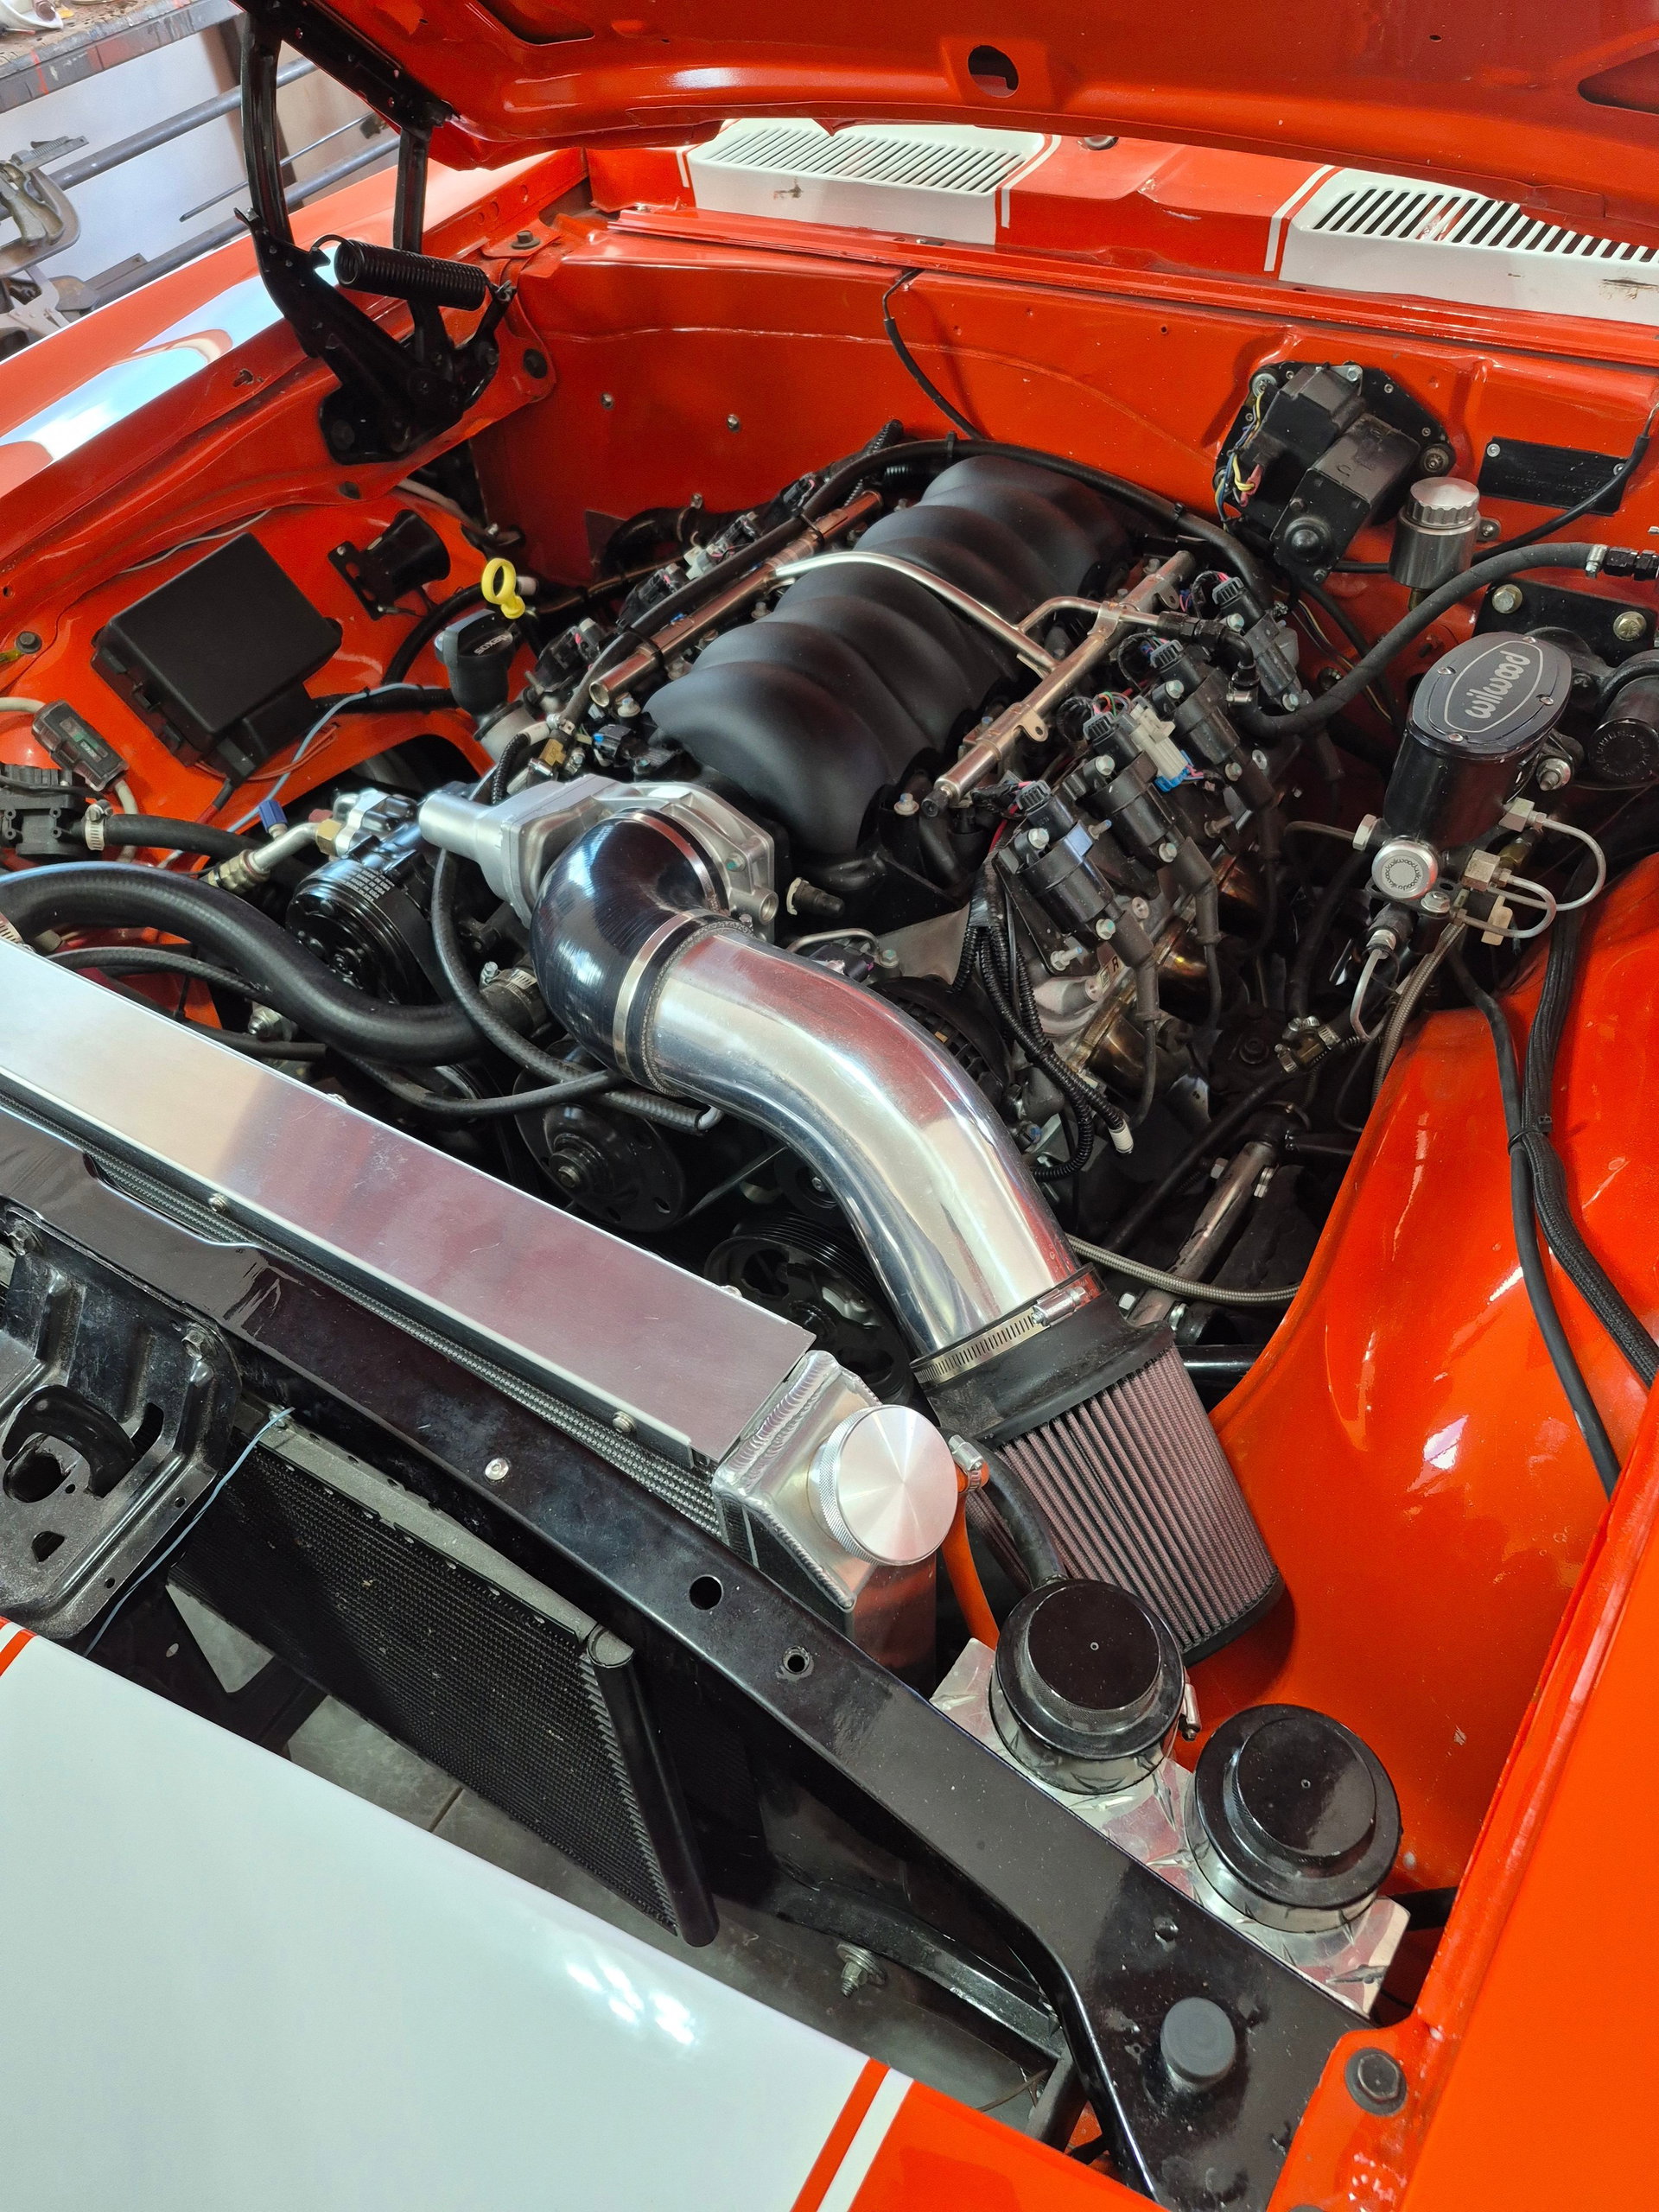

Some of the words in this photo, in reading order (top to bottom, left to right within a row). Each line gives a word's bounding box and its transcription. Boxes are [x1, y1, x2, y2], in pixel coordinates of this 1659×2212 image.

[1465, 650, 1530, 718] wilwood
[374, 886, 386, 895] USA
[380, 881, 391, 892] USA
[368, 889, 380, 899] USA
